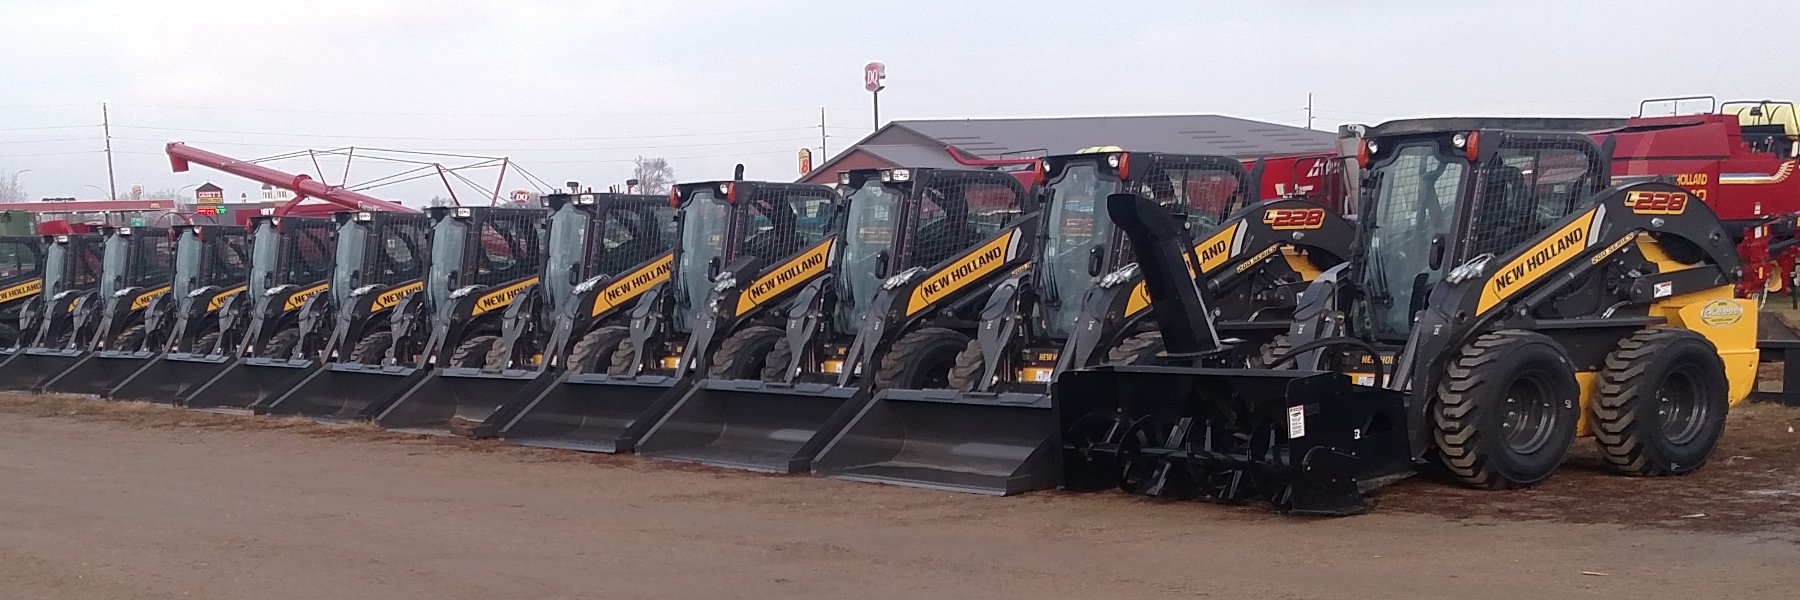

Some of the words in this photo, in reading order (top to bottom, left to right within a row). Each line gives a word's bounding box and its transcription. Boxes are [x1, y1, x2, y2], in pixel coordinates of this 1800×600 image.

[867, 69, 878, 85] DQ
[515, 193, 527, 201] DQ
[1608, 233, 1634, 254] SERIES
[1495, 266, 1525, 291] NEW
[1526, 227, 1583, 272] HOLLAND
[751, 278, 776, 299] NEW
[776, 252, 823, 285] HOLLAND
[923, 274, 949, 298] NEW
[951, 246, 1002, 282] HOLLAND
[483, 293, 505, 307] NEW
[607, 282, 631, 301] NEW
